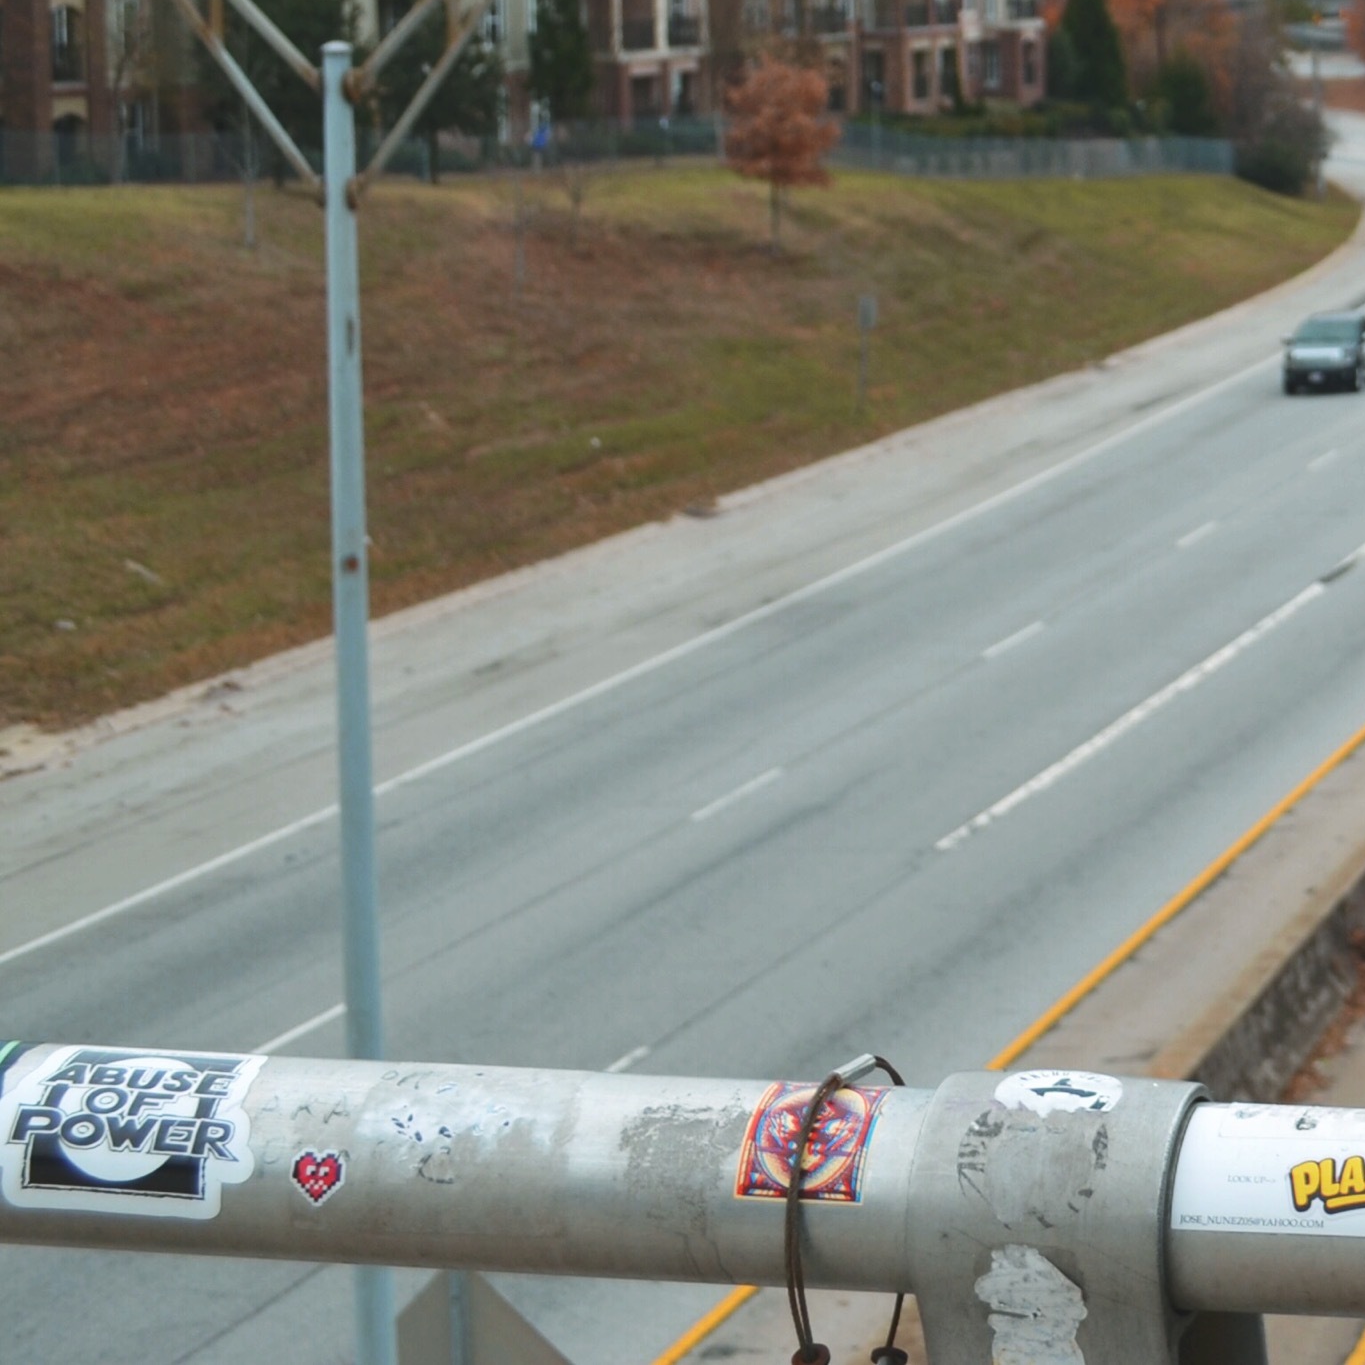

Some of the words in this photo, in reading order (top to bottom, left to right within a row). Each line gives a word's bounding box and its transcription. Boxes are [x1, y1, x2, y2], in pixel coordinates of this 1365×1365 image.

[42, 1062, 237, 1098] ABUSE
[84, 1086, 175, 1117] OF
[8, 1103, 238, 1162] POWER
